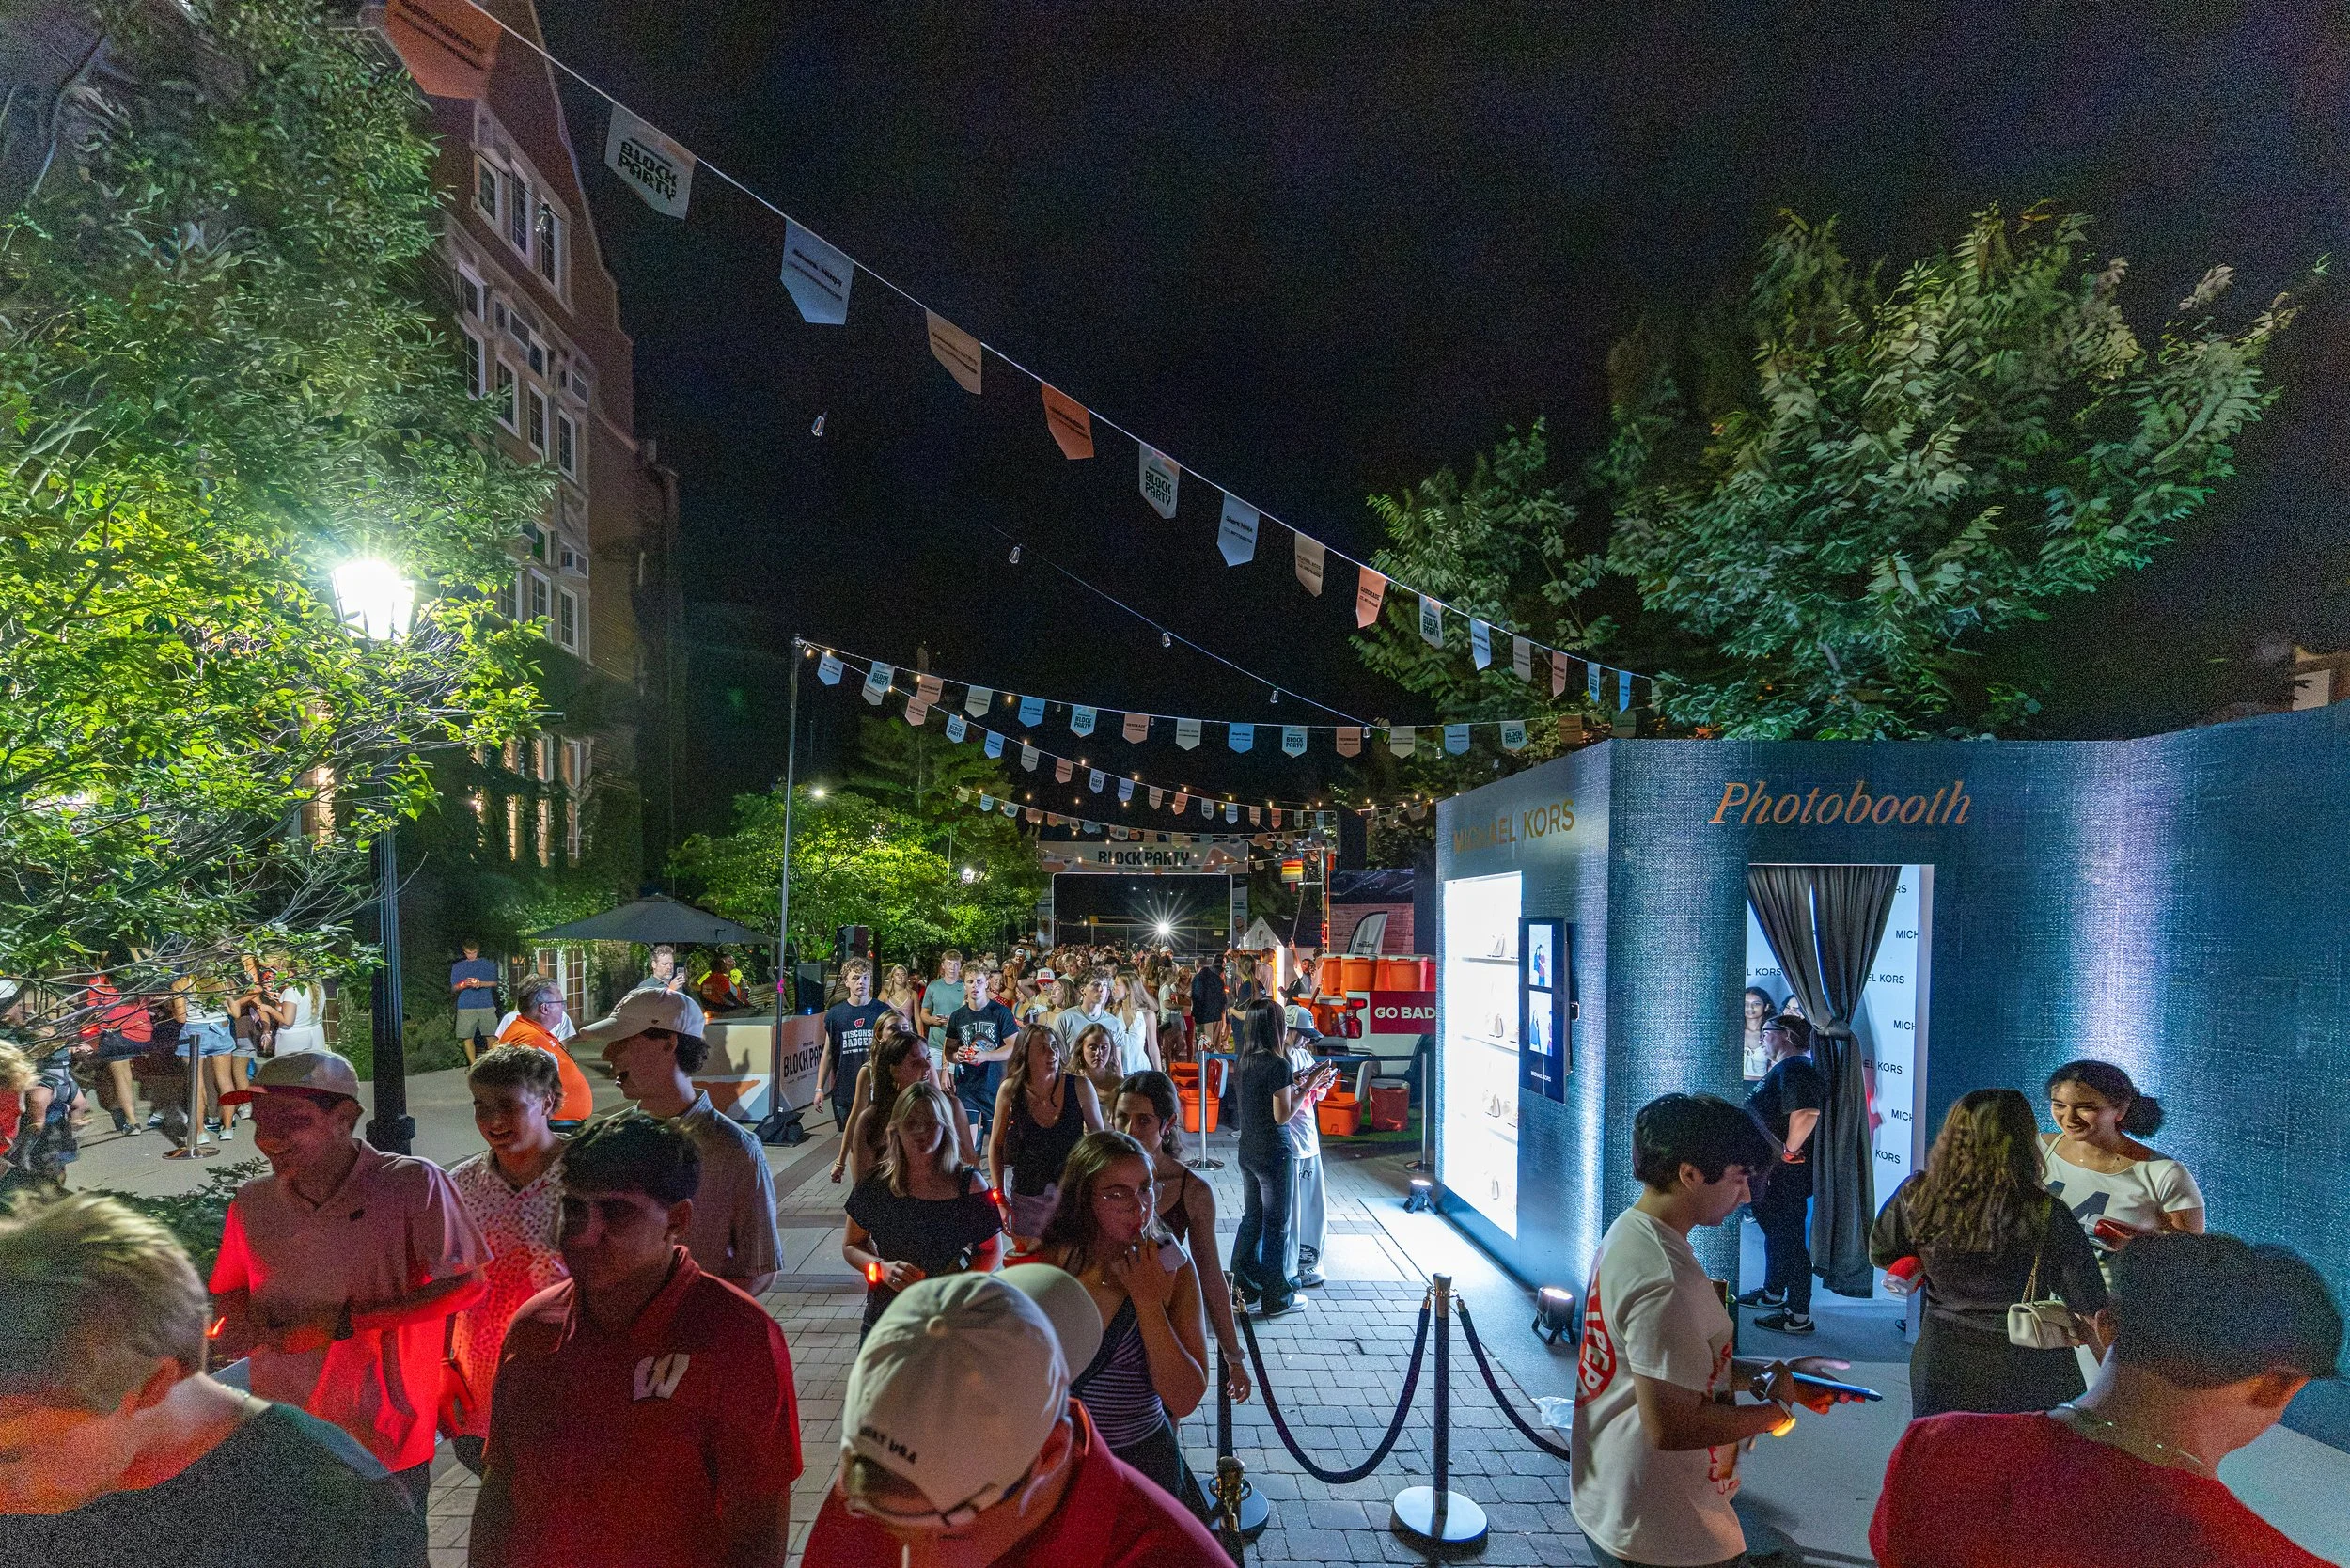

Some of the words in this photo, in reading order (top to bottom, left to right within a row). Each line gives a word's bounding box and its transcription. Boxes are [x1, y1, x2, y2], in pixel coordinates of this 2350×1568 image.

[1145, 470, 1171, 495] BLOCK
[1145, 481, 1171, 507] PARTY
[871, 678, 888, 686] PARTY
[872, 672, 889, 682] BLOCK
[1073, 721, 1091, 729] PARTY
[1074, 715, 1091, 724] BLOCK
[948, 729, 962, 738] PARTY
[949, 725, 963, 733] BLOCK
[1707, 779, 1972, 825] Photobooth
[1452, 812, 1517, 855] MICAEL
[1523, 799, 1575, 840] KORS
[1098, 850, 1142, 865] BLOCK
[1144, 851, 1190, 866] PARTY
[1879, 973, 1905, 984] KORS
[1374, 1006, 1398, 1019] GO
[1401, 1006, 1436, 1019] BAD
[783, 1048, 809, 1078] BLOCK
[1877, 1061, 1904, 1074] KORS
[1875, 1149, 1901, 1165] KORS
[633, 1353, 691, 1402] W
